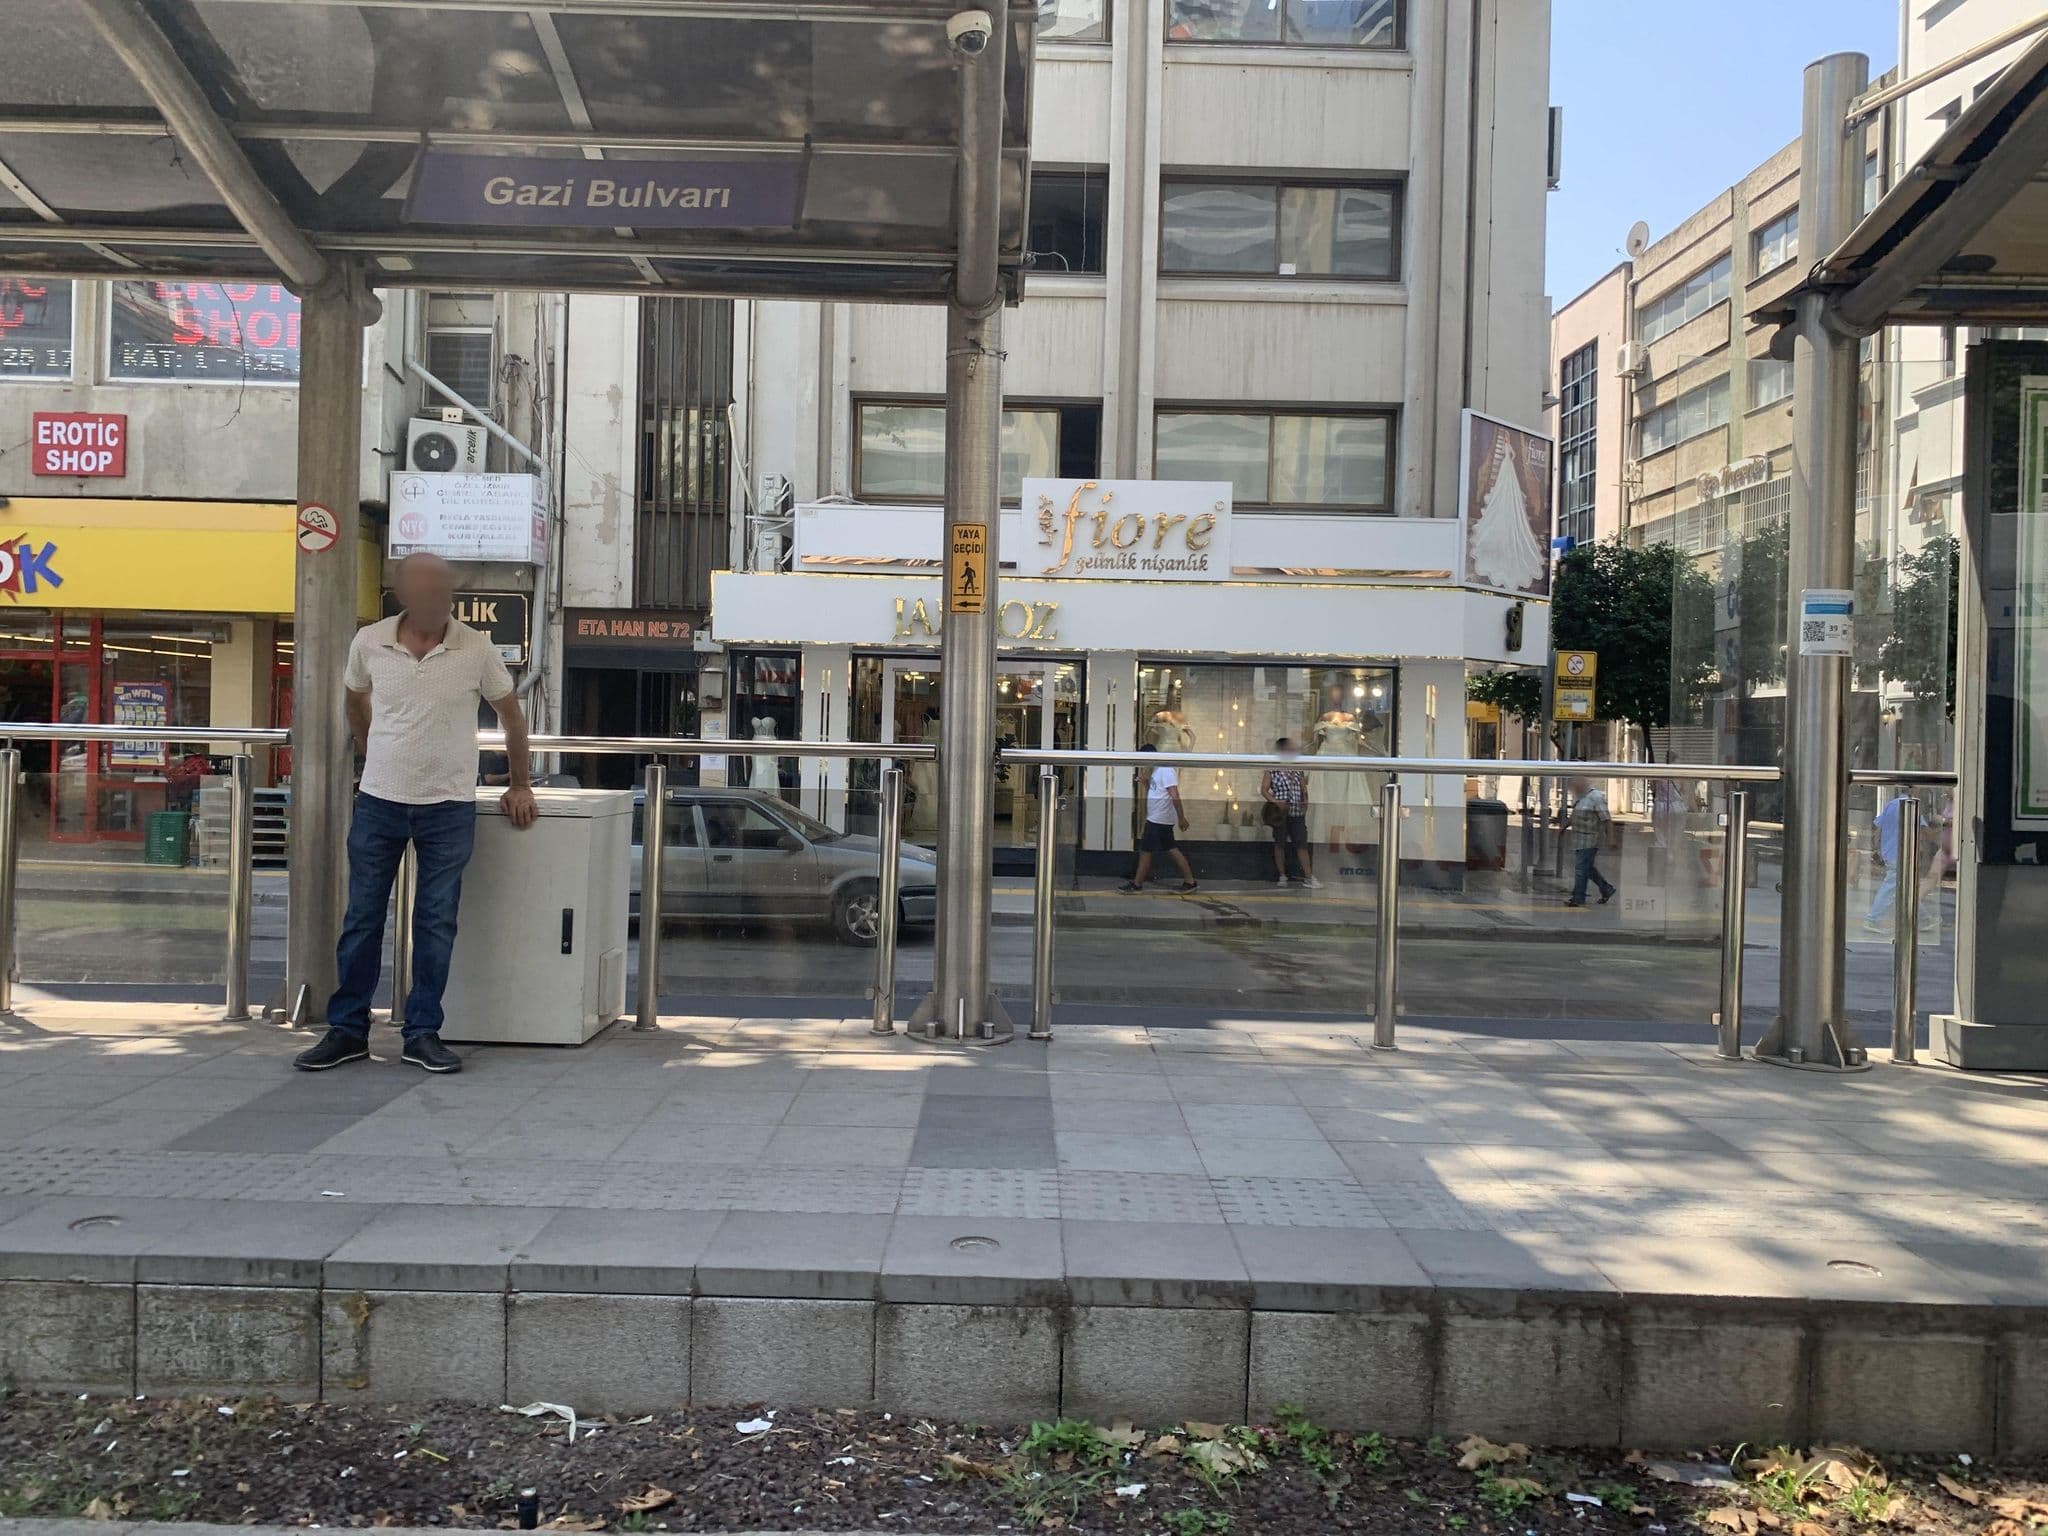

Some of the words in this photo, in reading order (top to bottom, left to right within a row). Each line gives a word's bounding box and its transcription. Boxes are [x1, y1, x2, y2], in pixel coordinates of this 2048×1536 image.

[483, 176, 574, 207] Gazi
[587, 180, 731, 208] Bulvarı
[38, 417, 119, 447] EROTİC
[466, 429, 478, 464] arçelik
[45, 449, 113, 472] SHOP
[957, 529, 980, 539] YAYA
[1041, 481, 1217, 575] fiore
[1140, 553, 1209, 574] nişanlık
[578, 619, 606, 637] ETA
[611, 620, 644, 637] HAN
[671, 622, 690, 639] 72
